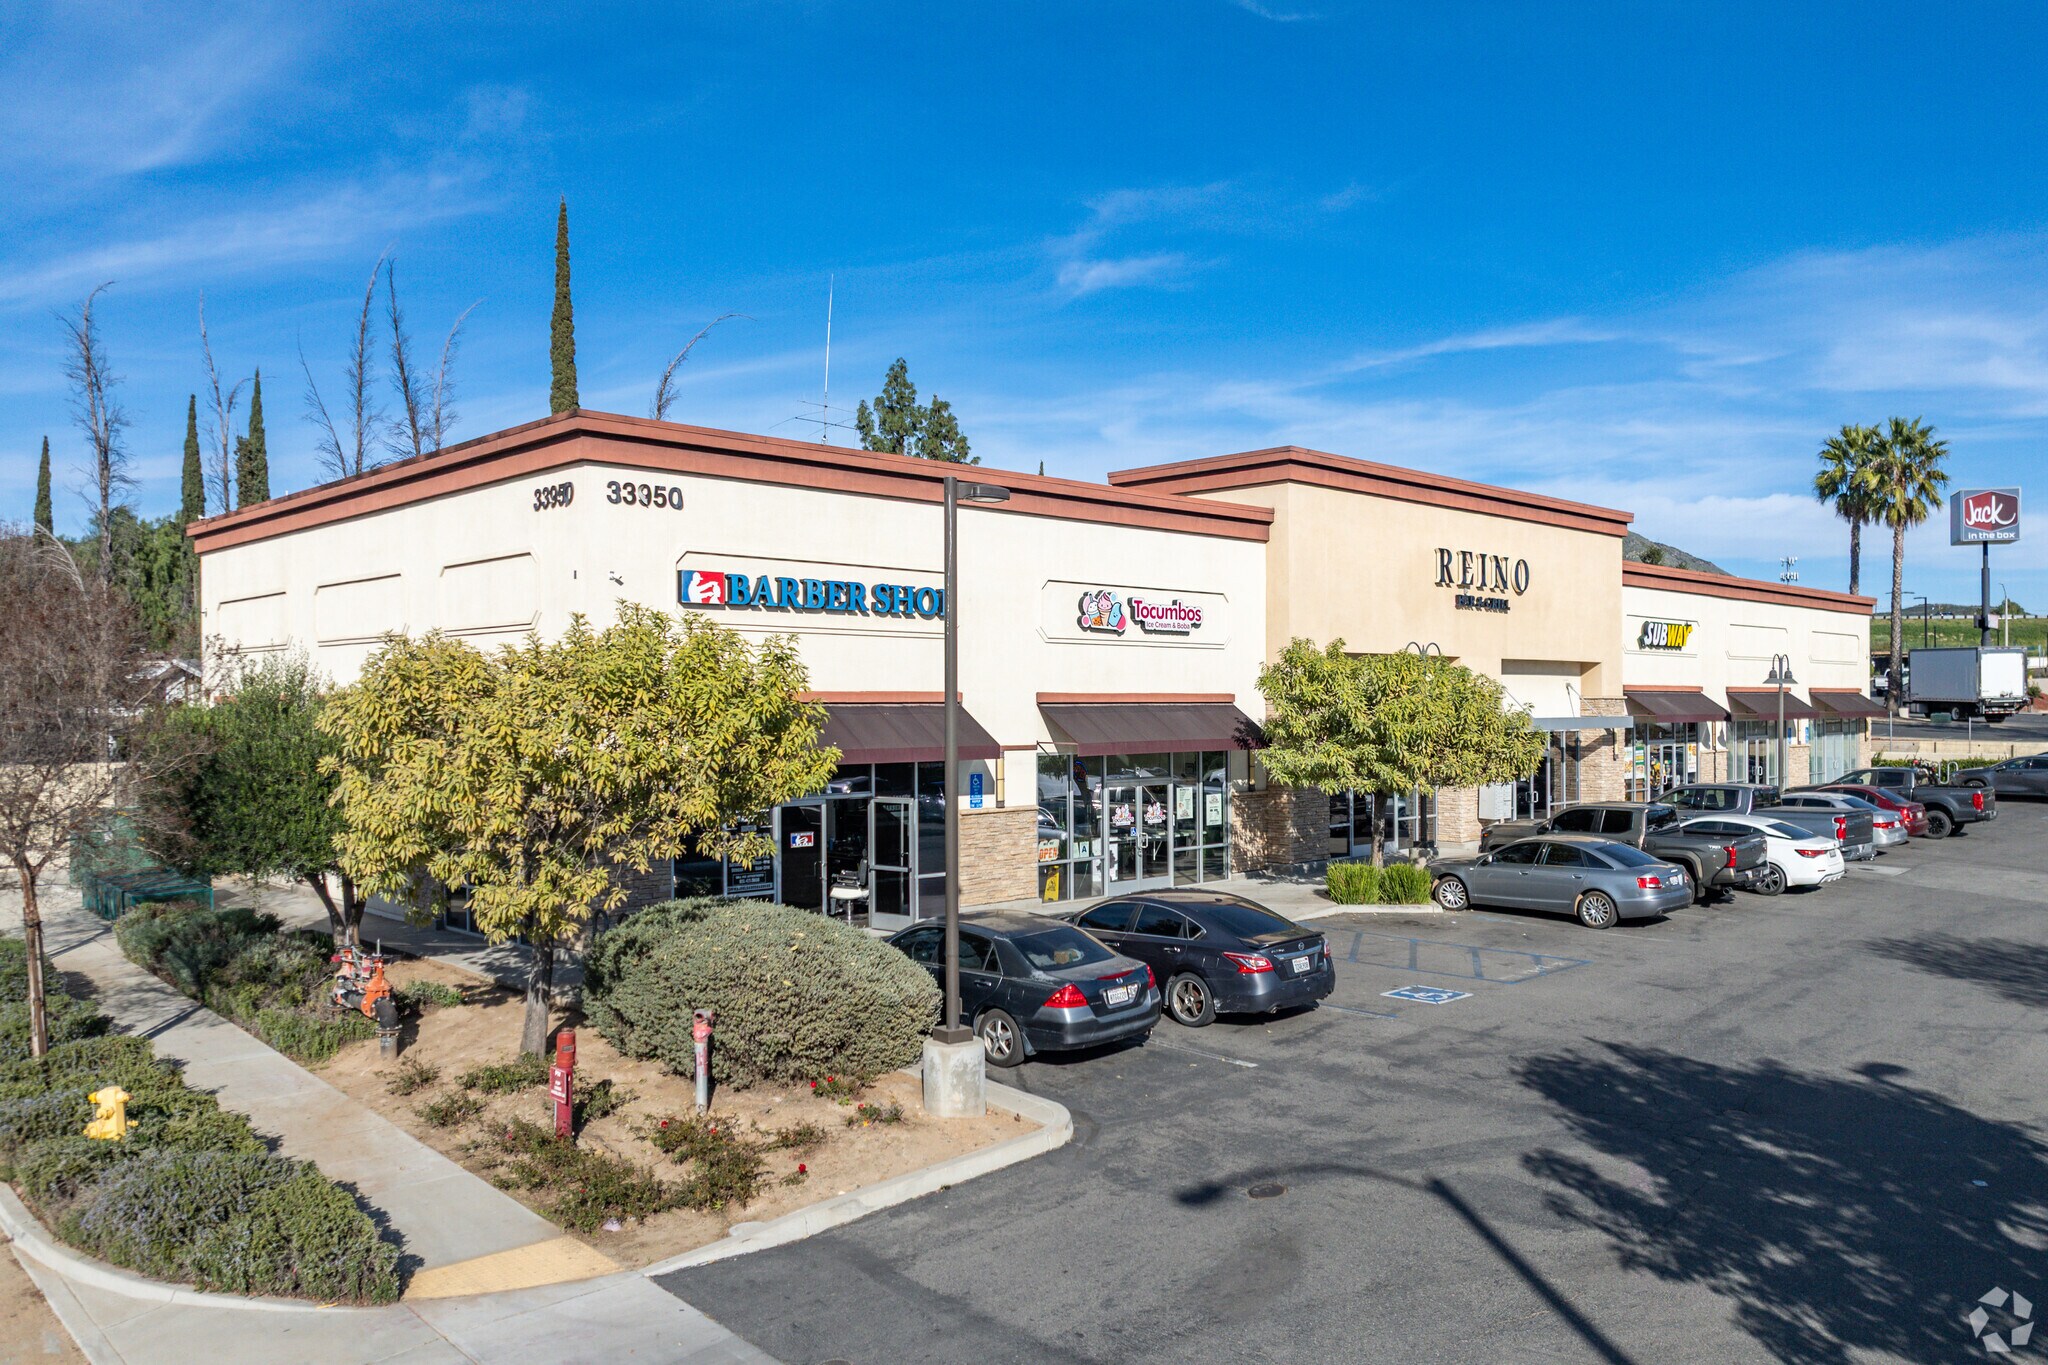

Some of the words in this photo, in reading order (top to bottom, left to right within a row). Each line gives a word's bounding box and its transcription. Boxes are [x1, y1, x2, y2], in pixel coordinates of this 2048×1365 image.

[533, 481, 575, 512] 33950
[606, 481, 684, 511] 33950
[1966, 495, 2016, 525] Jack
[1979, 531, 1995, 539] the
[1996, 531, 2015, 539] box
[1437, 547, 1530, 593] REINO
[725, 573, 869, 613] BARBER
[1134, 599, 1201, 622] Tocumbos
[1155, 621, 1172, 629] Cream
[1177, 622, 1190, 630] Boba
[1644, 622, 1693, 647] SUBWAY
[1039, 846, 1058, 860] OPEN
[1081, 845, 1088, 854] A
